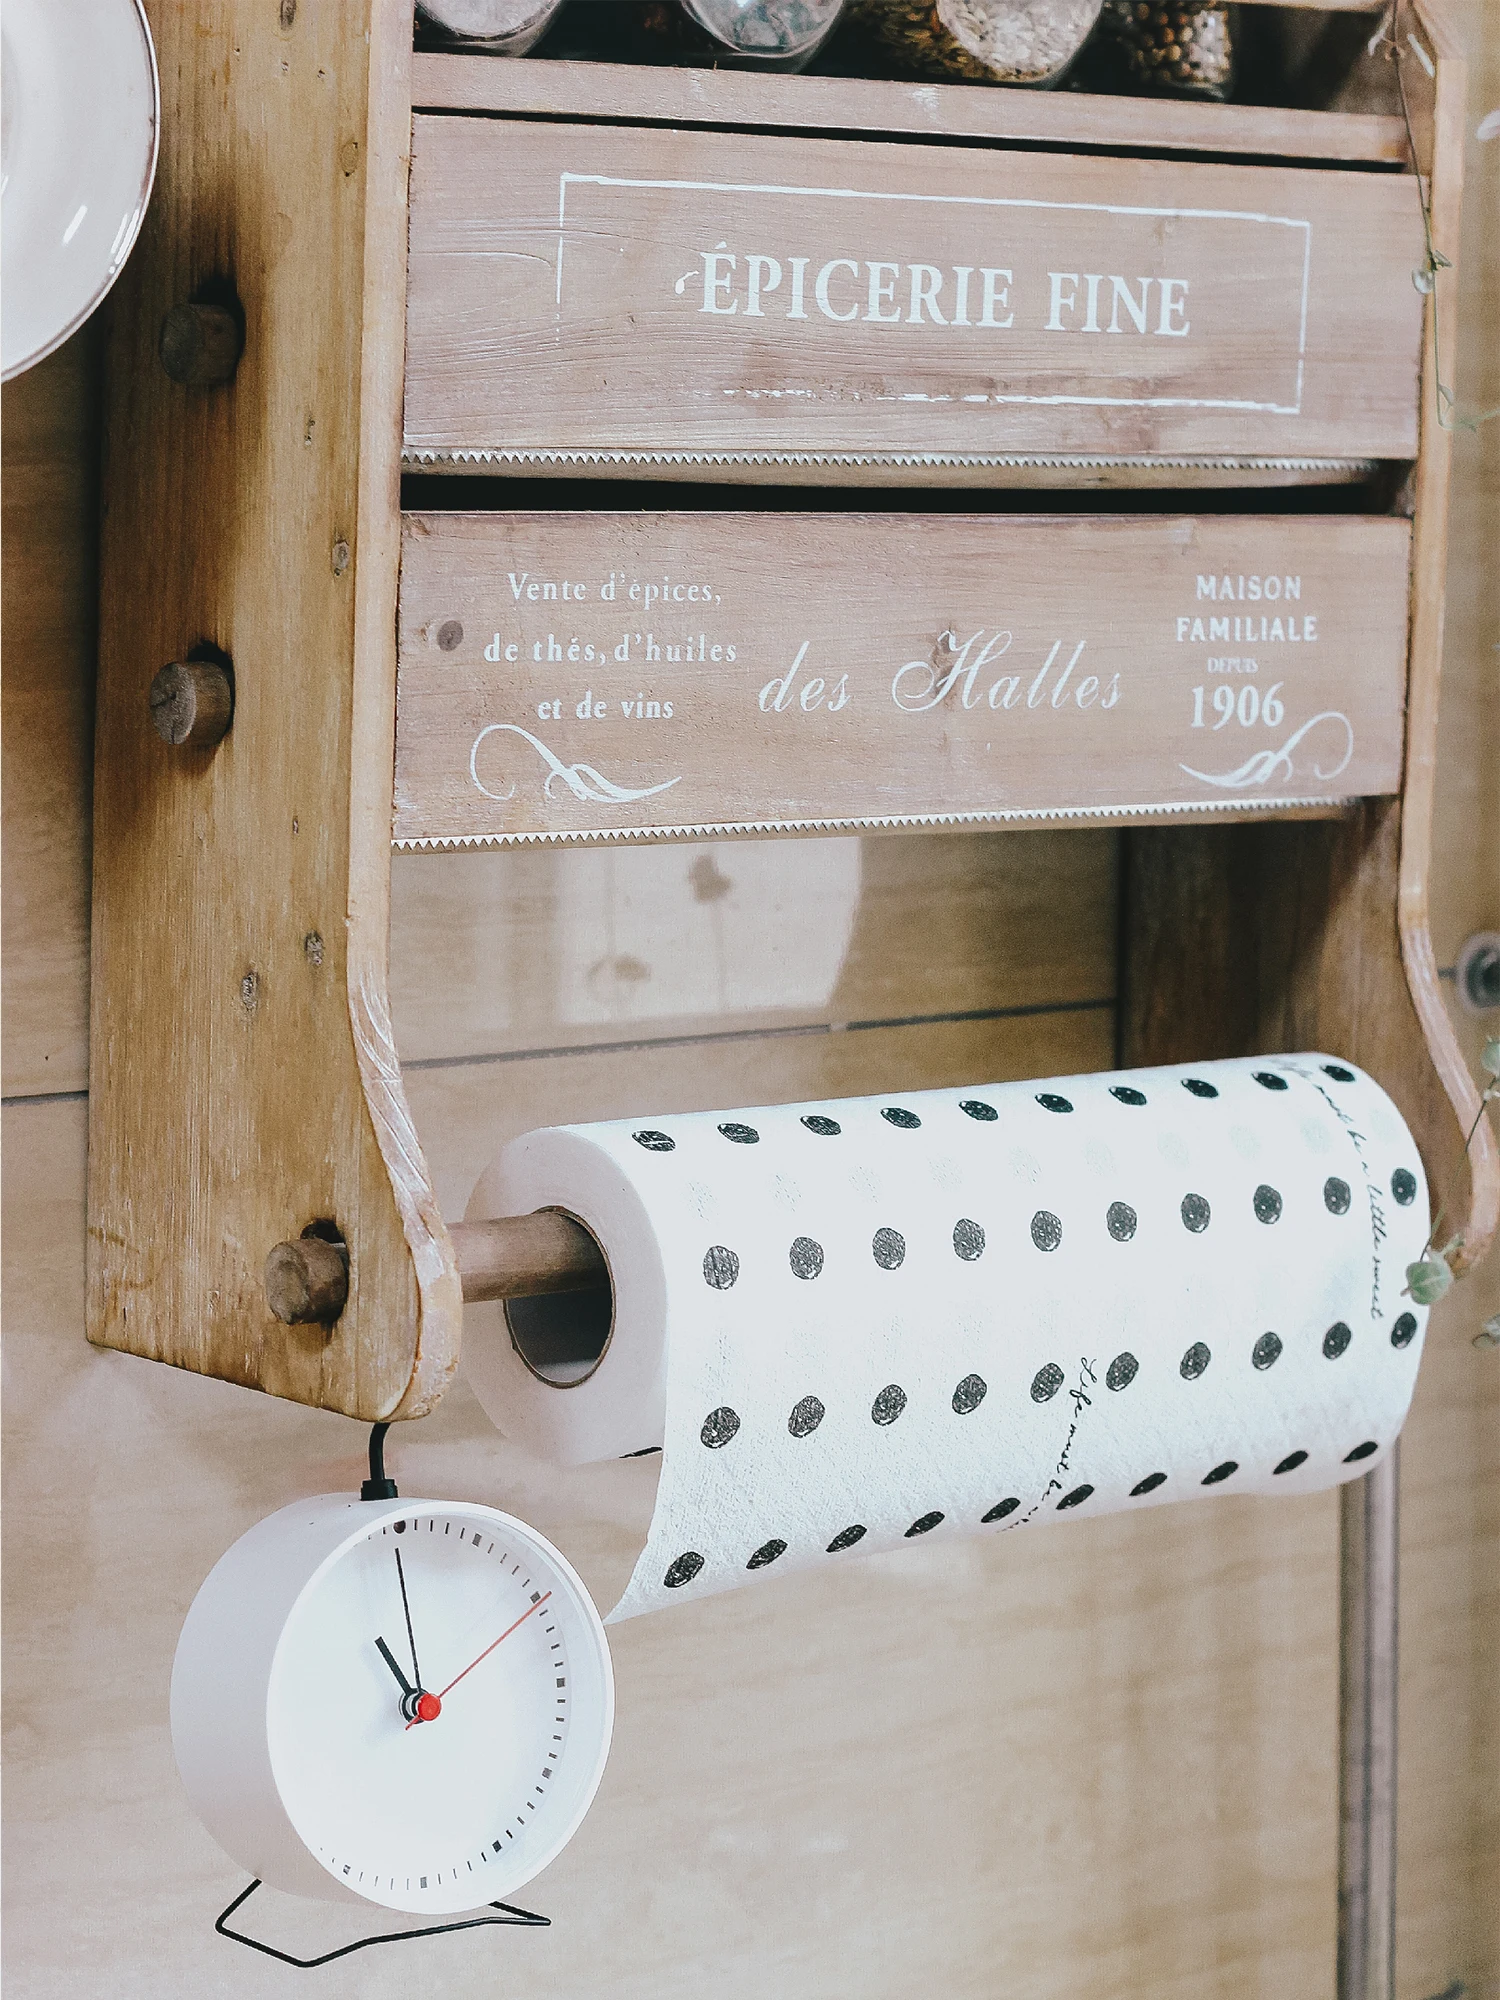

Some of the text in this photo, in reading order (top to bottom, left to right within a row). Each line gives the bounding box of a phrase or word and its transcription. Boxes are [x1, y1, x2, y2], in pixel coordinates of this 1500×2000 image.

[697, 241, 1191, 338] ÉPICERIE FINE
[508, 573, 587, 601] Vente
[1196, 574, 1301, 600] MAISON
[484, 633, 519, 662] de
[1176, 616, 1318, 642] FAMILIALE
[758, 630, 1121, 712] des Halles
[1207, 656, 1259, 674] DEPUIS
[537, 691, 674, 719] et de vins
[1190, 680, 1285, 731] 1906
[1366, 1184, 1387, 1252] little
[1370, 1255, 1384, 1320] sweet
[1069, 1356, 1098, 1418] Life
[1056, 1423, 1077, 1474] must
